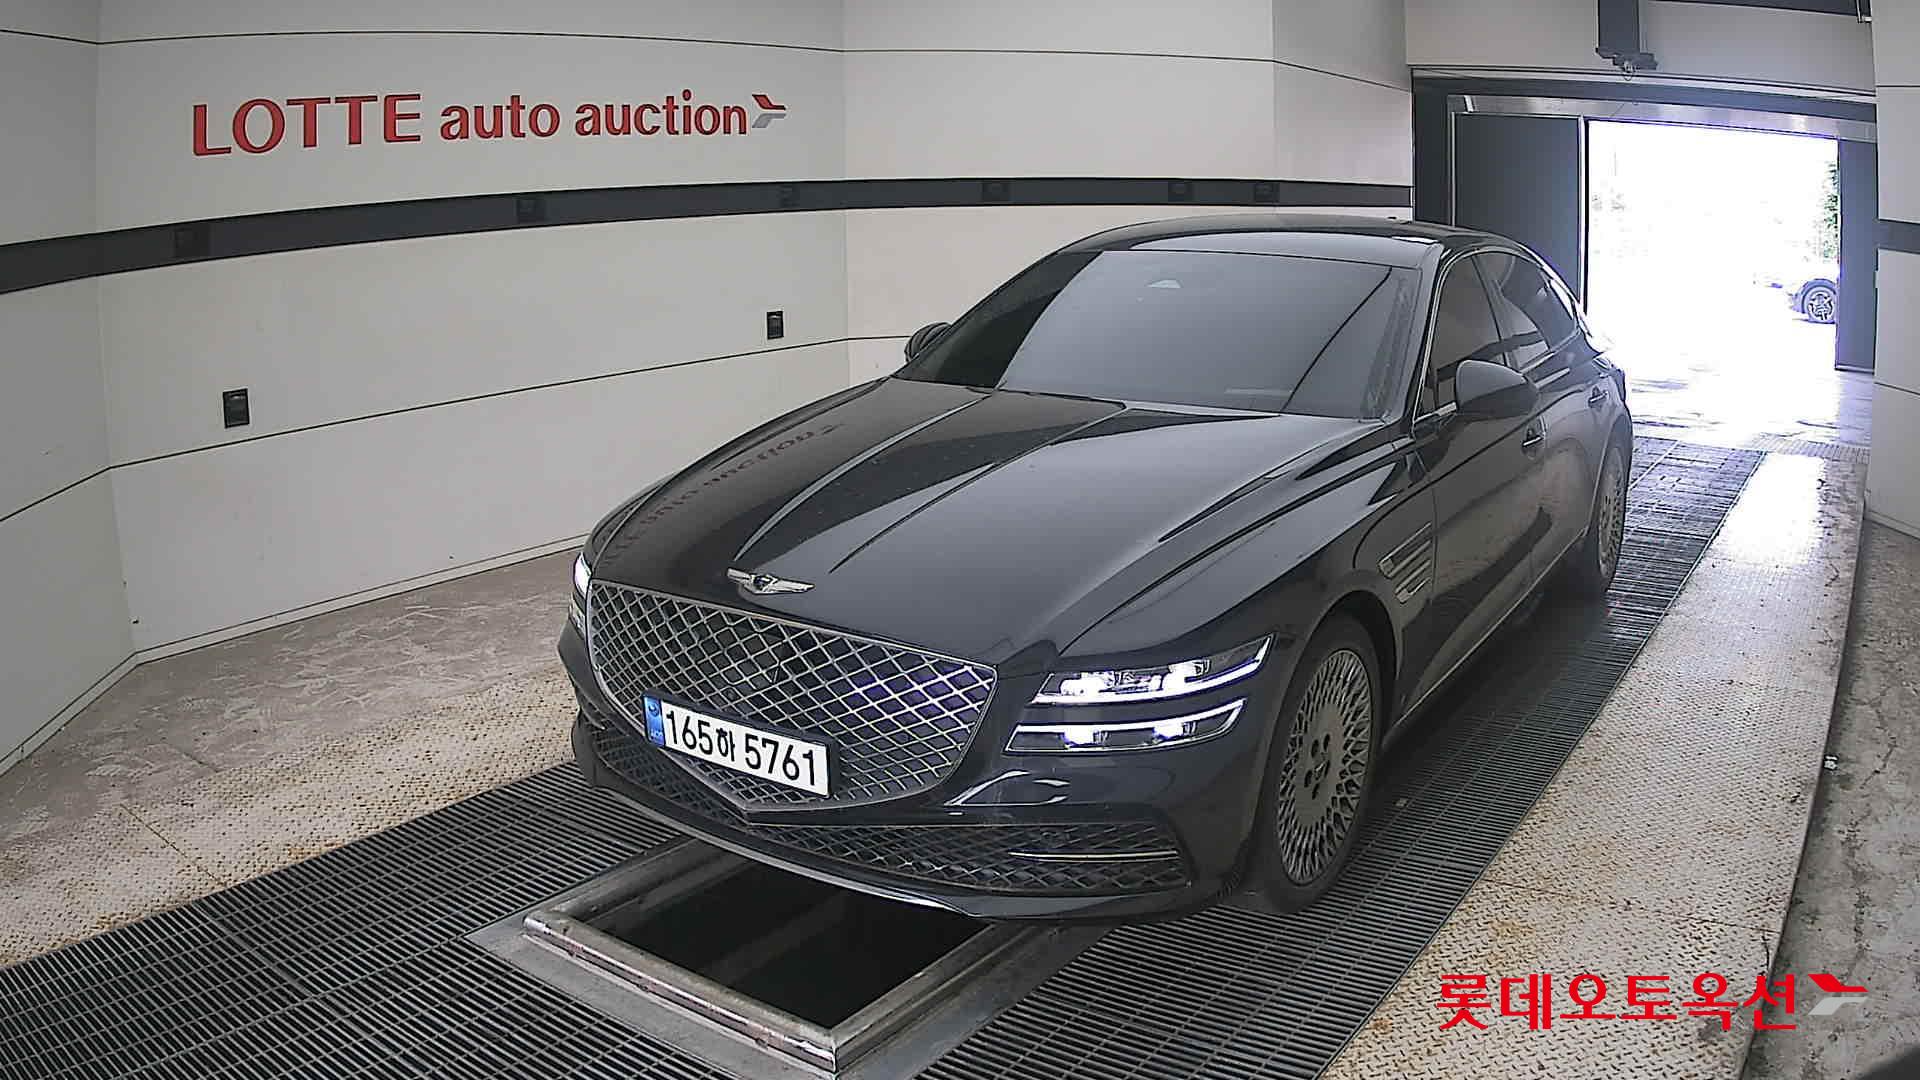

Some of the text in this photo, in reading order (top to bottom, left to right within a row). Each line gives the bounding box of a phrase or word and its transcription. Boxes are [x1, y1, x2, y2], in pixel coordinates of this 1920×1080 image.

[192, 90, 748, 156] LOTTE auto auction
[666, 710, 815, 785] 165하 5761
